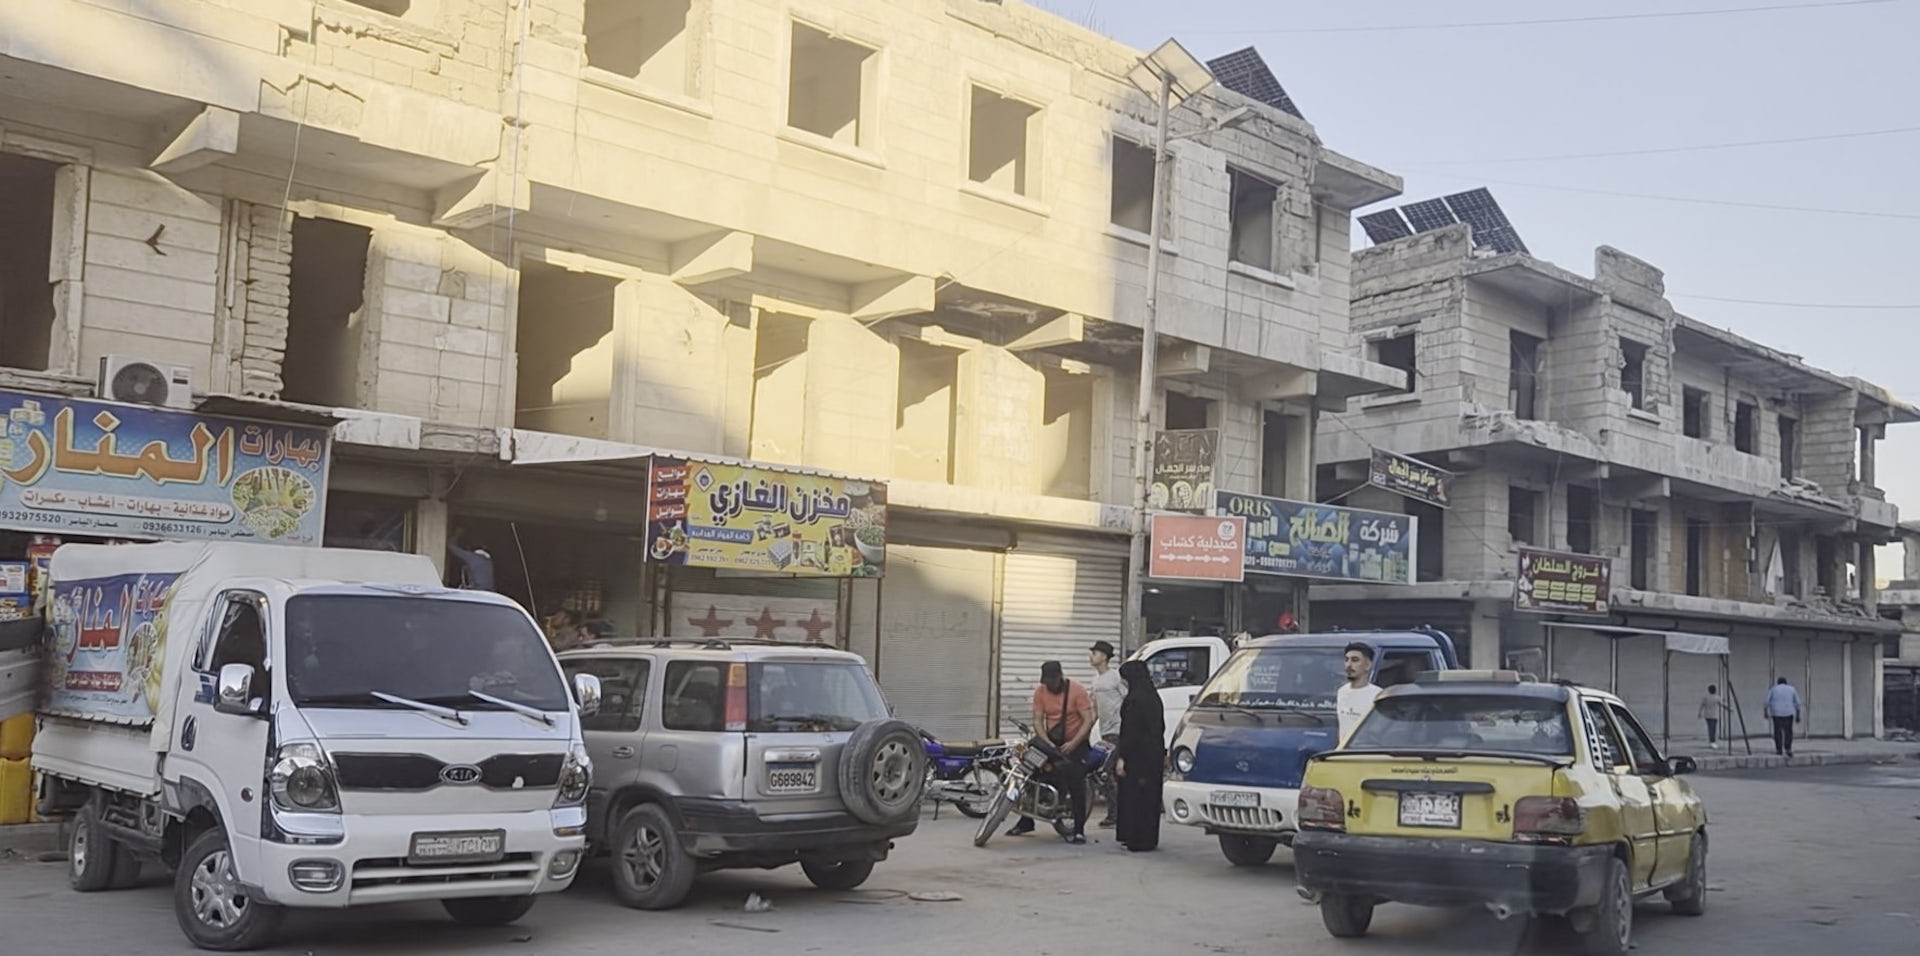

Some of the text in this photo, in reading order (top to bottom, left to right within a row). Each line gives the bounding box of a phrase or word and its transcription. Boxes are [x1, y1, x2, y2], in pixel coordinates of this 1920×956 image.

[1, 406, 322, 487] بهارات المنار
[24, 490, 66, 505] مكسرات
[656, 487, 686, 499] بهارات
[77, 495, 115, 510] أعشاب
[127, 499, 162, 516] بهارات
[709, 479, 852, 525] مخزن الغازي
[1229, 496, 1272, 517] ORIS
[210, 506, 230, 520] مواد
[142, 522, 202, 534] 0936633126
[1289, 508, 1399, 547] شركة الصالح
[1197, 536, 1238, 552] صيدلية
[1533, 556, 1599, 582] فروج السلطان
[66, 583, 137, 666] المنار
[450, 769, 473, 780] KIA
[771, 772, 814, 787] G689842
